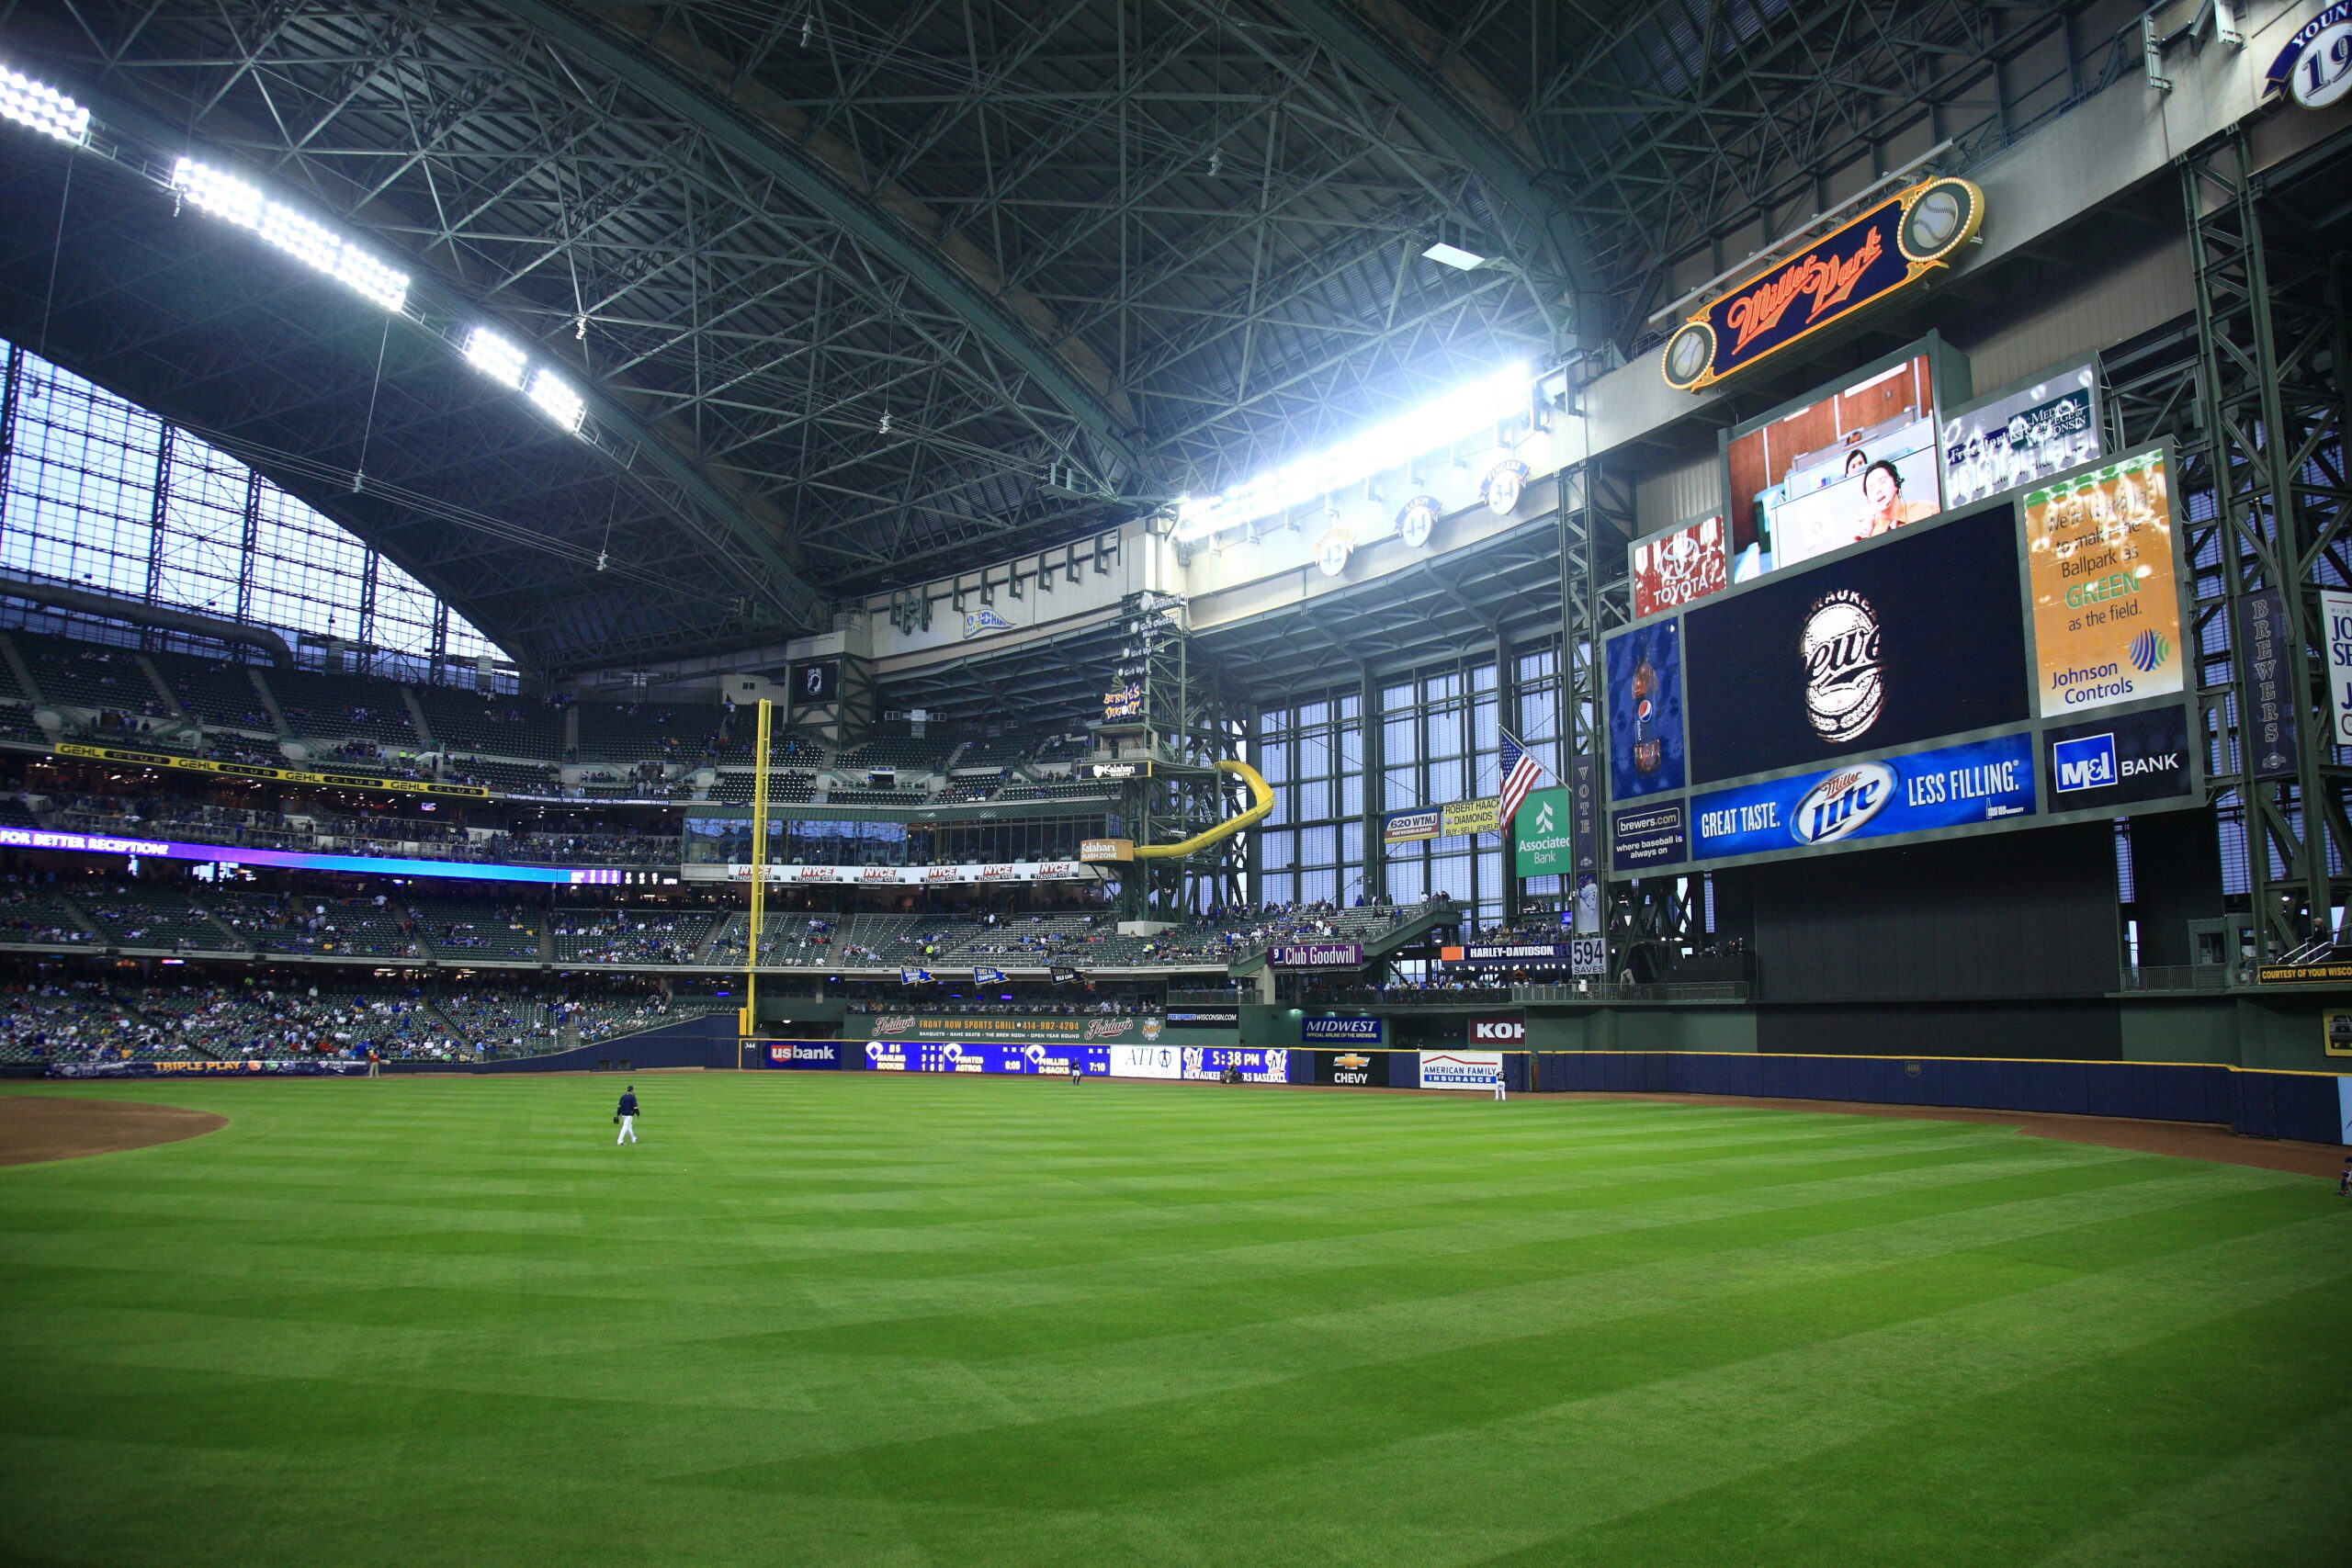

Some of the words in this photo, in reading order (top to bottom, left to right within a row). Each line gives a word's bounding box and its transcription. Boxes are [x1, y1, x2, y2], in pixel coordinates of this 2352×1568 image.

[2291, 2, 2352, 49] YOUN
[1727, 254, 1818, 355] Miller
[1799, 226, 1883, 323] Park
[1494, 478, 1514, 504] 34
[1407, 513, 1427, 537] 44
[1323, 544, 1341, 565] 42
[2062, 551, 2118, 579] Ballpark
[2122, 546, 2139, 561] as
[1653, 575, 1709, 606] TOYOTA
[2065, 570, 2140, 609] GREEN
[2068, 619, 2082, 632] as
[2086, 610, 2106, 627] the
[2110, 599, 2143, 622] field.
[1131, 649, 1142, 658] Get
[1143, 647, 1152, 656] Up
[1136, 666, 1145, 675] Up
[2052, 662, 2118, 689] Johnson
[2252, 599, 2279, 743] BREWERS
[1103, 682, 1140, 705] BERNIE'S
[2064, 677, 2133, 705] Controls
[61, 745, 101, 758] GEHL
[112, 752, 163, 763] CLUB
[178, 760, 216, 771] GEHL
[226, 766, 271, 776] CLUB
[286, 772, 321, 783] GEHL
[331, 777, 376, 787] CLUB
[390, 782, 427, 792] GEHL
[435, 786, 477, 795] CLUB
[1104, 762, 1136, 774] Kalahari
[2061, 751, 2110, 787] M&I
[2120, 753, 2179, 777] BANK
[1820, 770, 1862, 799] Miller
[1907, 774, 1946, 807] LESS
[1445, 802, 1476, 815] ROBERT
[1578, 766, 1590, 834] VOTE
[1453, 811, 1493, 825] DIAMONDS
[1809, 777, 1881, 844] Lite
[1390, 818, 1412, 829] 620
[1412, 815, 1437, 827] WTMJ
[1620, 814, 1677, 832] brewers.com
[1701, 809, 1738, 839] GREAT
[1740, 802, 1781, 833] TASTE.
[0, 830, 31, 845] FOR
[33, 834, 85, 849] BETTER
[1392, 827, 1431, 836] NEWSRADIO
[1081, 841, 1115, 853] Kalahari
[1616, 841, 1640, 852] where
[1641, 836, 1674, 850] baseball
[1676, 834, 1683, 842] is
[1534, 850, 1556, 864] Bank
[1630, 849, 1657, 859] always
[1658, 847, 1668, 855] on
[801, 866, 835, 876] NYCE
[864, 867, 897, 877] NYCE
[928, 867, 957, 878] NYCE
[983, 865, 1012, 876] NYCE
[1039, 863, 1069, 874] NYCE
[1285, 947, 1306, 964] Club
[1310, 945, 1355, 964] Goodwill
[1470, 945, 1555, 958] HARLEY-DAVIDSON
[1574, 940, 1604, 964] 594
[1574, 965, 1605, 974] SAVES
[2262, 969, 2296, 979] COURTESY
[2297, 969, 2307, 977] OF
[2307, 968, 2327, 977] YOUR
[872, 1015, 916, 1036] Friday's
[920, 1020, 942, 1029] FRONT
[944, 1020, 962, 1029] ROW
[965, 1021, 993, 1029] SPORTS
[995, 1021, 1016, 1030] GRILL
[1022, 1021, 1080, 1031] 414-902-4204
[1084, 1017, 1134, 1040] Friday's
[1306, 1021, 1376, 1032] MIDWEST
[153, 1062, 202, 1071] TRIPLE
[206, 1061, 242, 1071] PLAY
[877, 1062, 905, 1070] ROCKIES
[1125, 1048, 1154, 1066] ATI
[1213, 1051, 1241, 1066] 5:38
[1244, 1054, 1260, 1066] PM
[956, 1064, 982, 1073] ASTROS
[1183, 1070, 1220, 1080] MILWAUKEE
[1253, 1073, 1287, 1083] BASEBALL
[1424, 1066, 1464, 1075] AMERICAN
[1334, 1073, 1368, 1084] CHEVY
